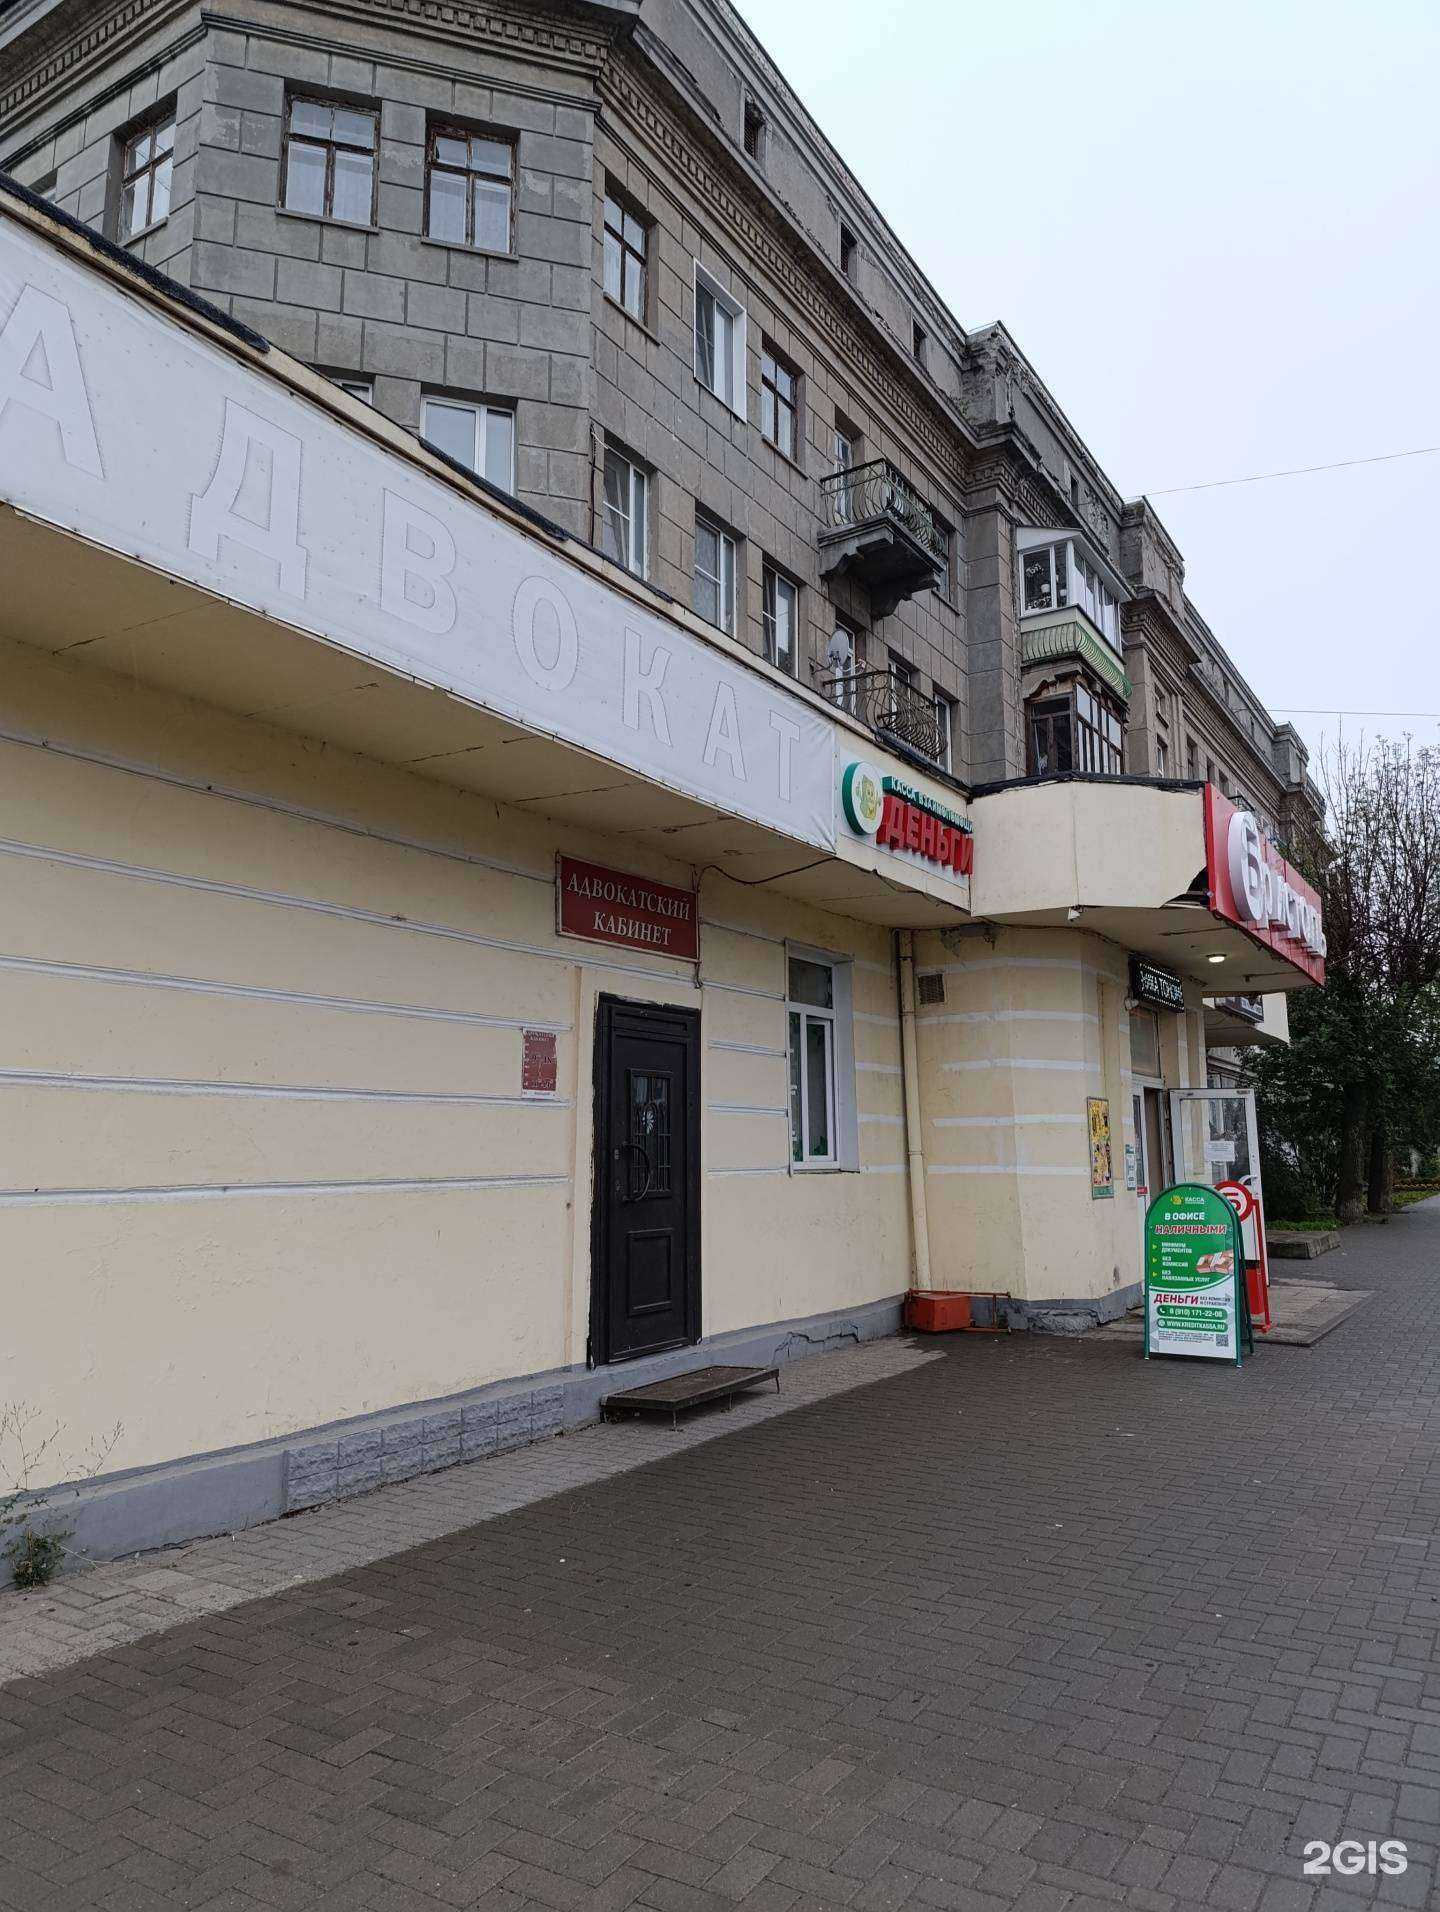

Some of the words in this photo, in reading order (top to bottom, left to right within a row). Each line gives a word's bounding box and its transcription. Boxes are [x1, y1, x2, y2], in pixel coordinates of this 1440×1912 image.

[0, 283, 801, 805] АДВОКАТ
[891, 777, 917, 801] КАССА
[877, 794, 974, 876] ДЕНЬГИ
[566, 872, 690, 921] АДВОКАТСКИЙ
[593, 911, 672, 946] КАБИНЕТ
[1155, 1224, 1227, 1235] НАЛИЧНЫМИ
[1164, 1212, 1171, 1220] В
[1172, 1211, 1205, 1221] ОФИСЕ
[1153, 1293, 1199, 1305] ДЕНЬГИ
